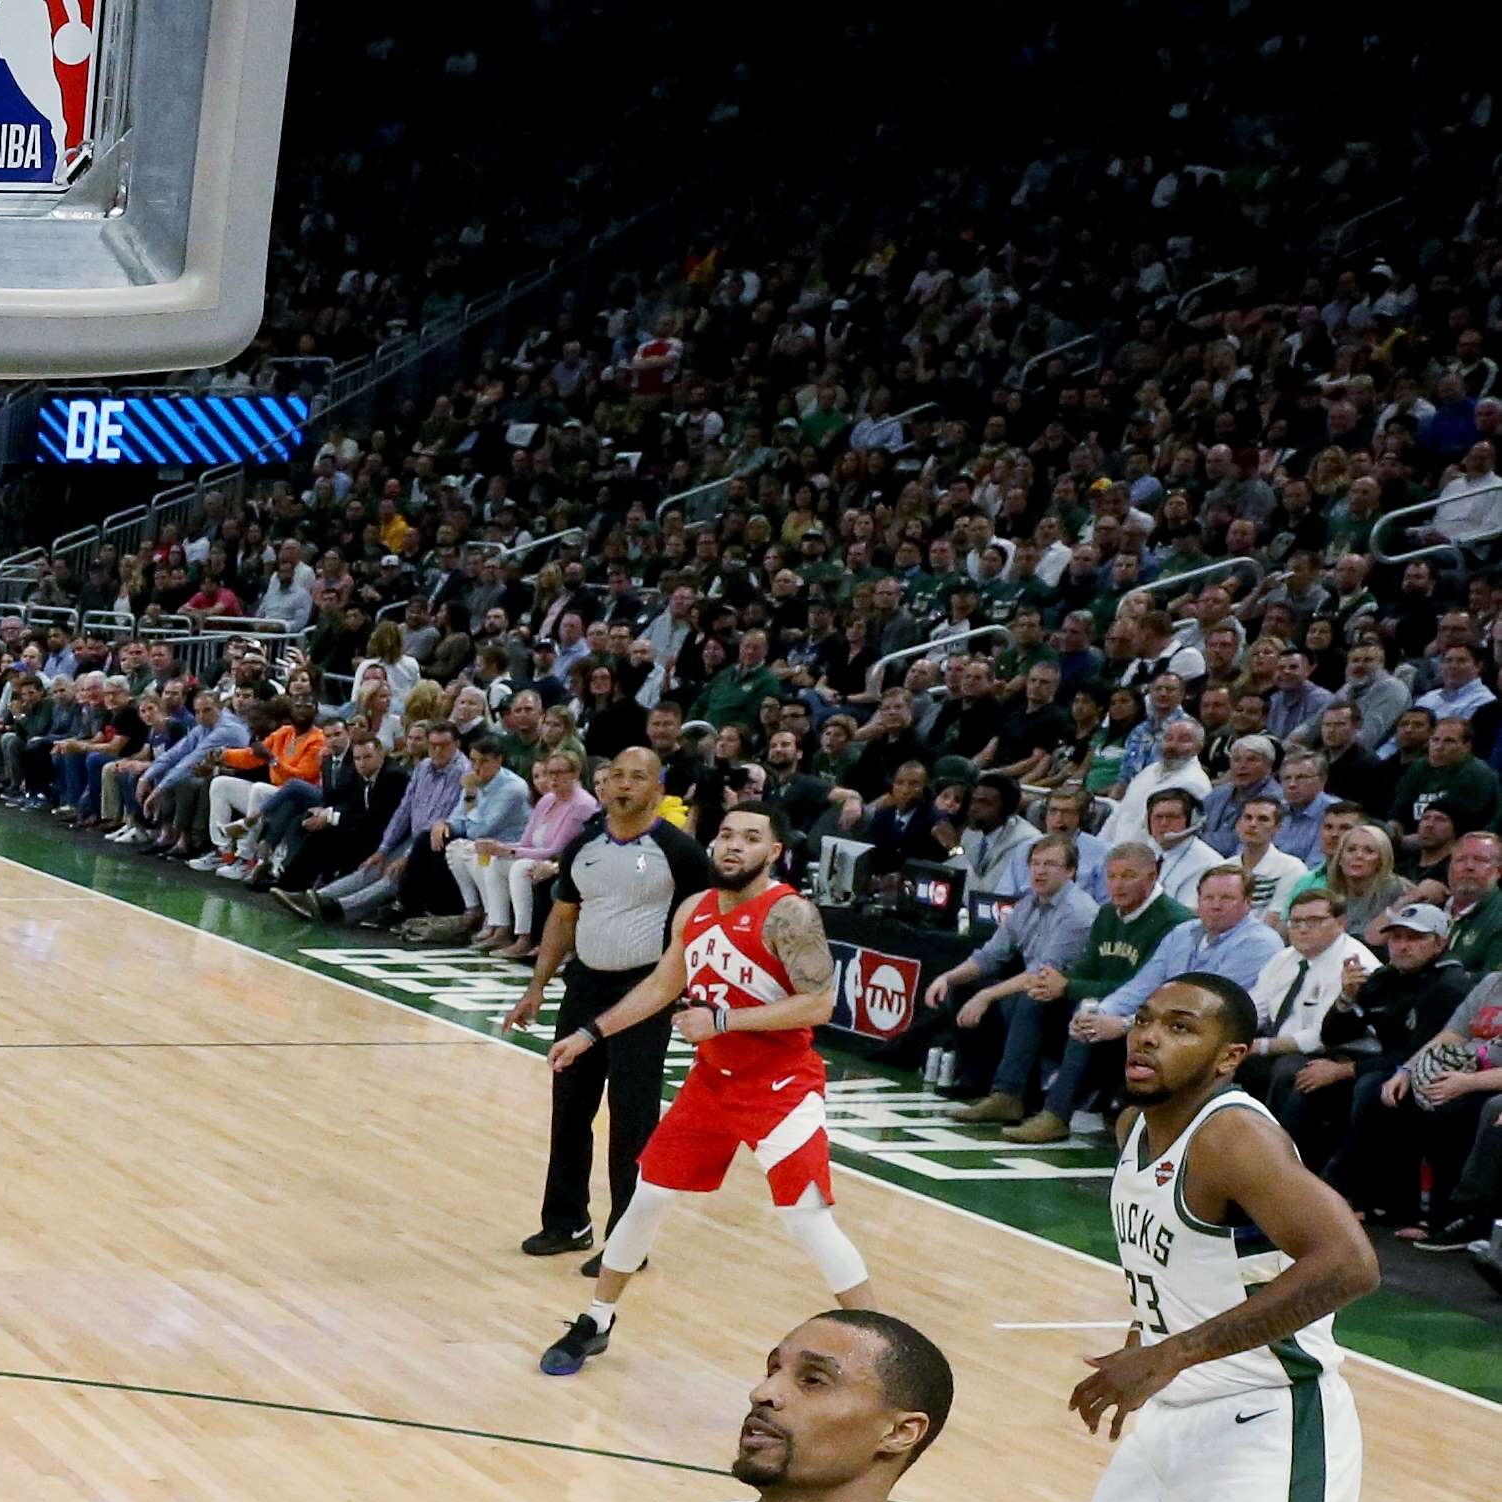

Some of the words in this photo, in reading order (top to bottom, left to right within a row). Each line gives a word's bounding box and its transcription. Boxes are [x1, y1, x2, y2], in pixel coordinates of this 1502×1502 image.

[65, 400, 124, 460] DE
[688, 936, 754, 986] ORTH
[867, 982, 907, 1015] TNT
[1113, 1203, 1175, 1268] UCKS
